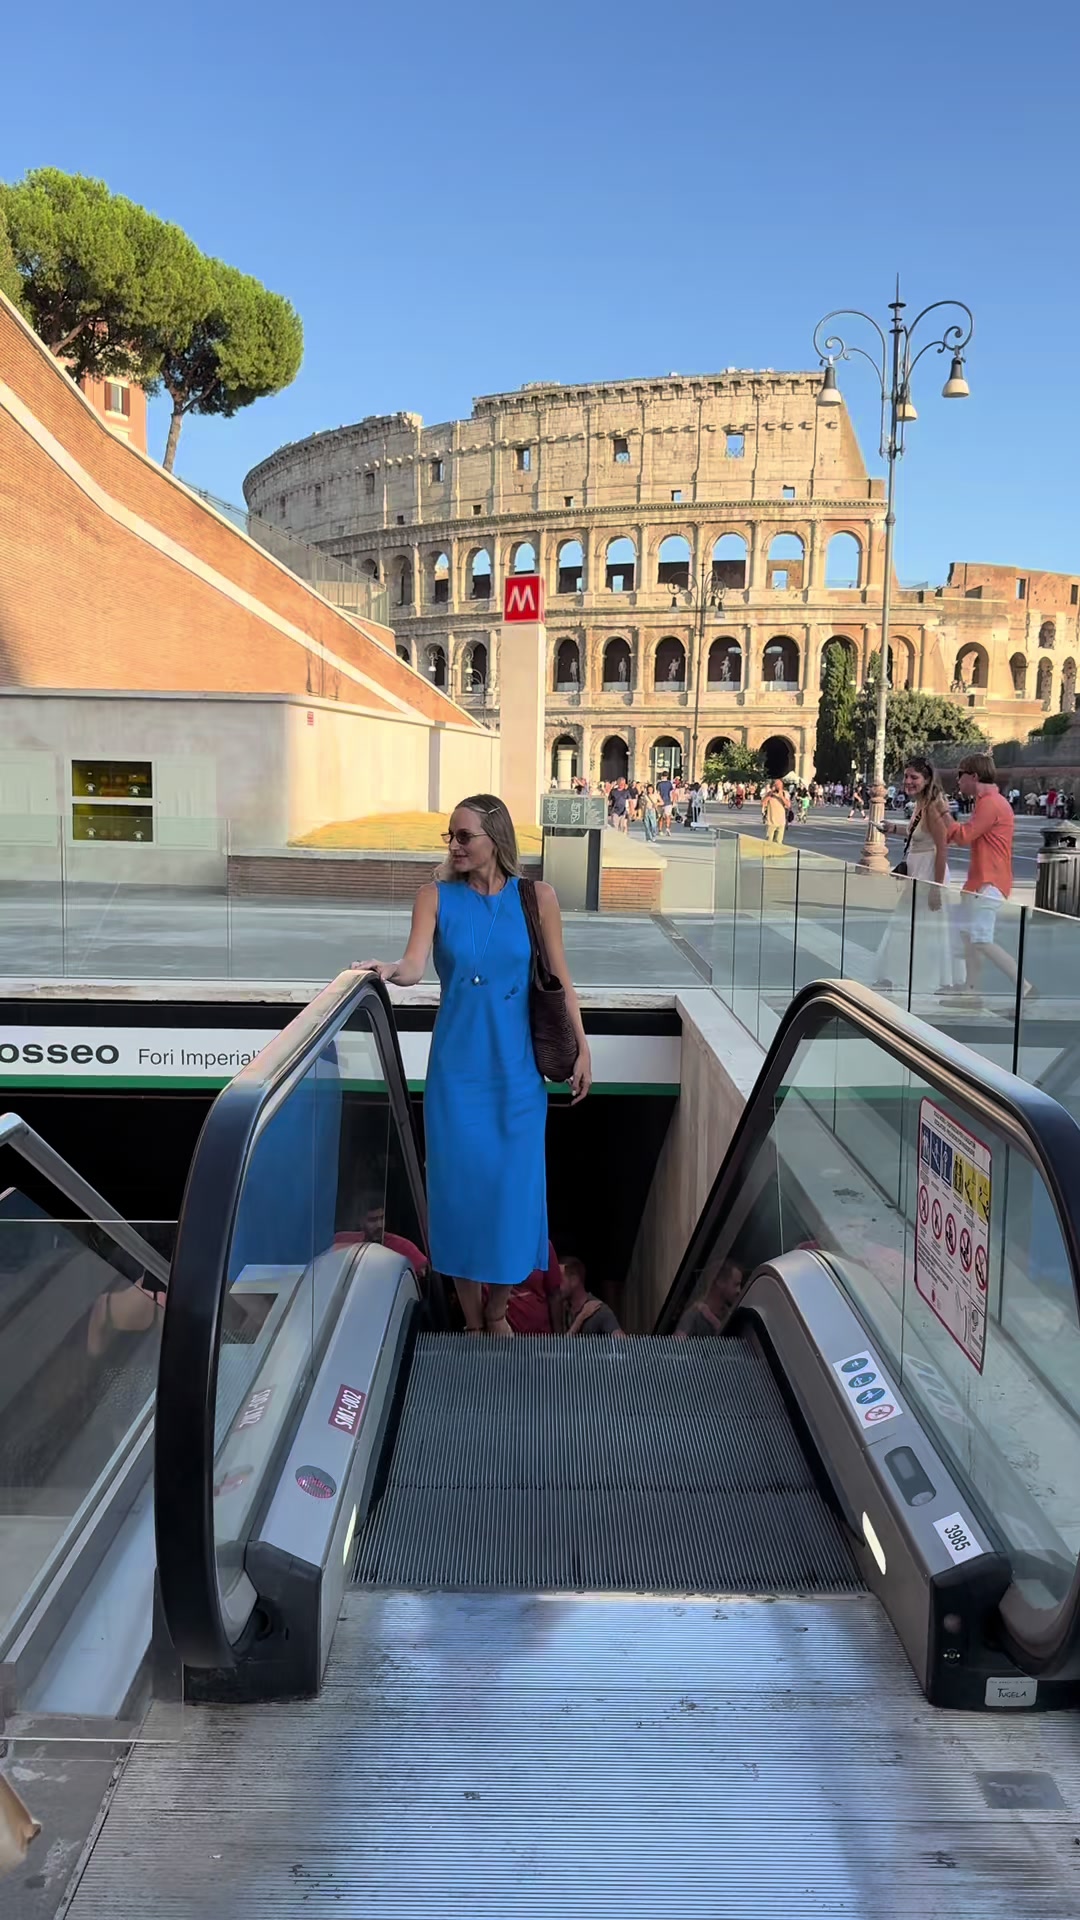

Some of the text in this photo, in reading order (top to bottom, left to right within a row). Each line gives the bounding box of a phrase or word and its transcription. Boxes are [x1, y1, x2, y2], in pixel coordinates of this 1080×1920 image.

[507, 585, 535, 612] M
[0, 1043, 119, 1064] osseo
[139, 1048, 260, 1069] Fori Imperial
[945, 1524, 971, 1551] 3985
